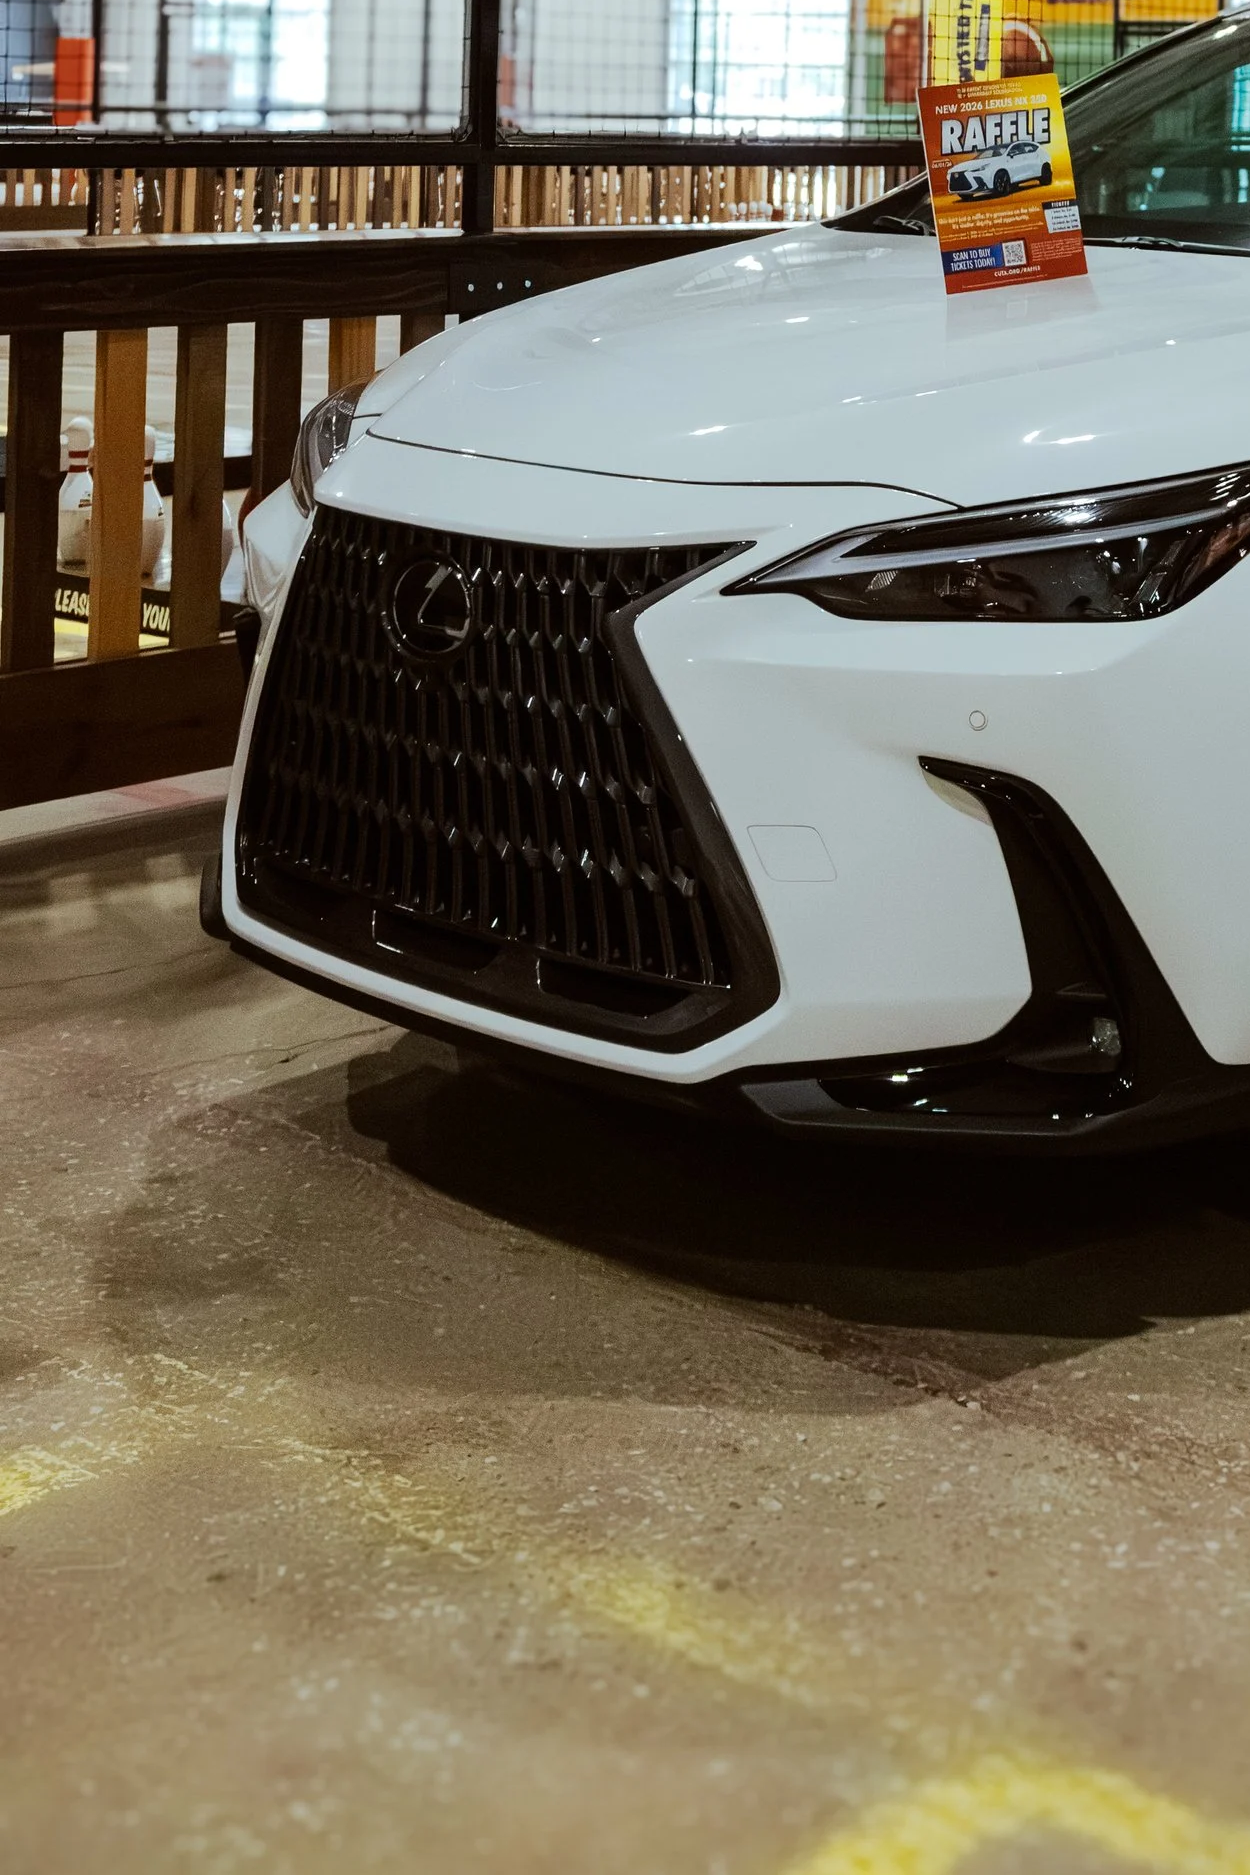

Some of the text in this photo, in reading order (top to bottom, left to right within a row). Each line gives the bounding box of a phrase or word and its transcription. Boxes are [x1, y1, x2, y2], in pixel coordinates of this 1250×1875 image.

[935, 101, 958, 115] NEW
[960, 102, 983, 112] 2026
[985, 98, 1013, 110] LEXUS
[941, 108, 1050, 156] RAFFLE
[952, 248, 990, 261] SCAN TO BUY
[951, 259, 996, 271] TICKETS TODAY!
[55, 588, 170, 632] LEAS YOU
